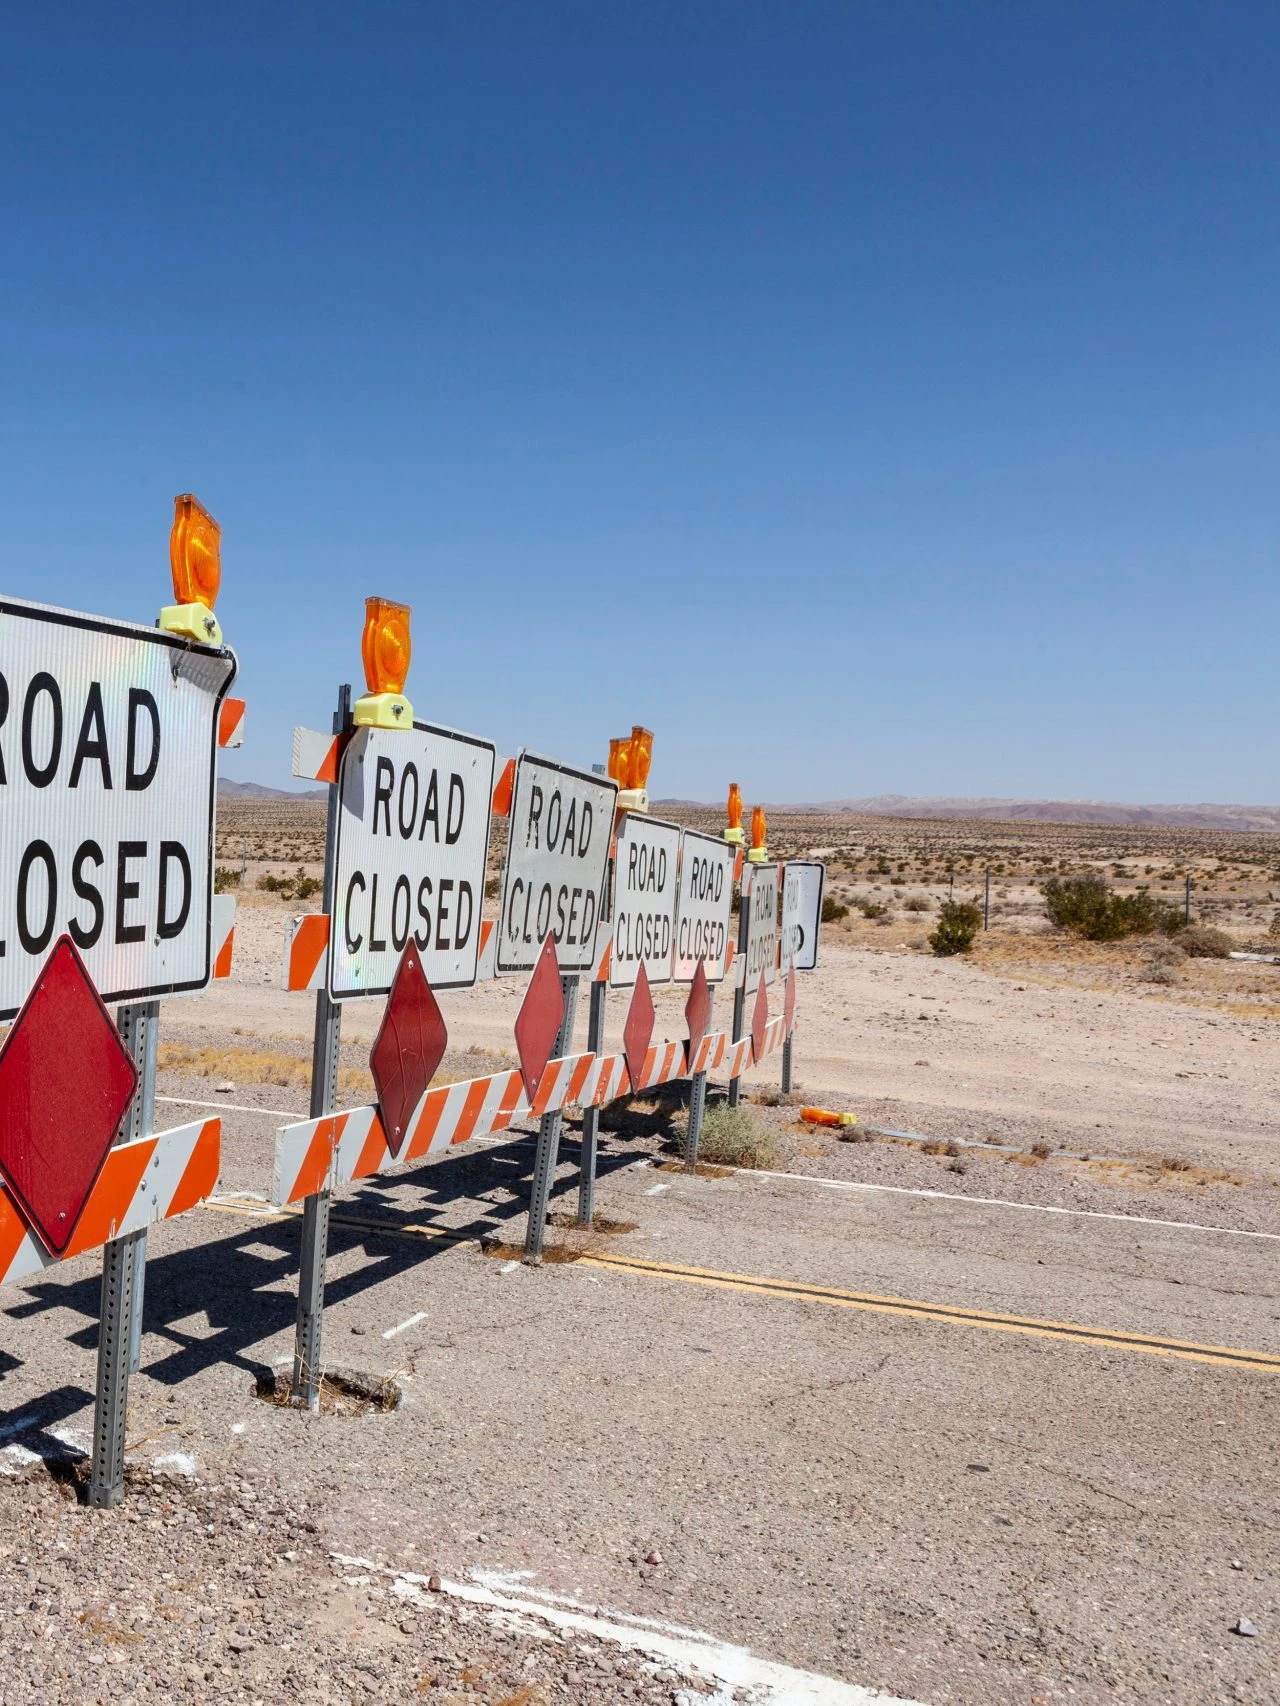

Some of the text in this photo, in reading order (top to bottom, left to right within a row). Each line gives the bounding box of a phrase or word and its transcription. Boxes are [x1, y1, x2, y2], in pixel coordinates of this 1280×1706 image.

[372, 755, 465, 844] ROAD
[526, 784, 593, 858] ROAD
[628, 841, 667, 893] ROAD
[690, 856, 724, 903] ROAD
[344, 870, 473, 955] CLOSED
[507, 877, 596, 946] CLOSED
[754, 883, 774, 922] ROAD
[616, 911, 670, 962] CLOSED
[679, 917, 725, 961] CLOSED
[748, 932, 775, 976] CLOSED
